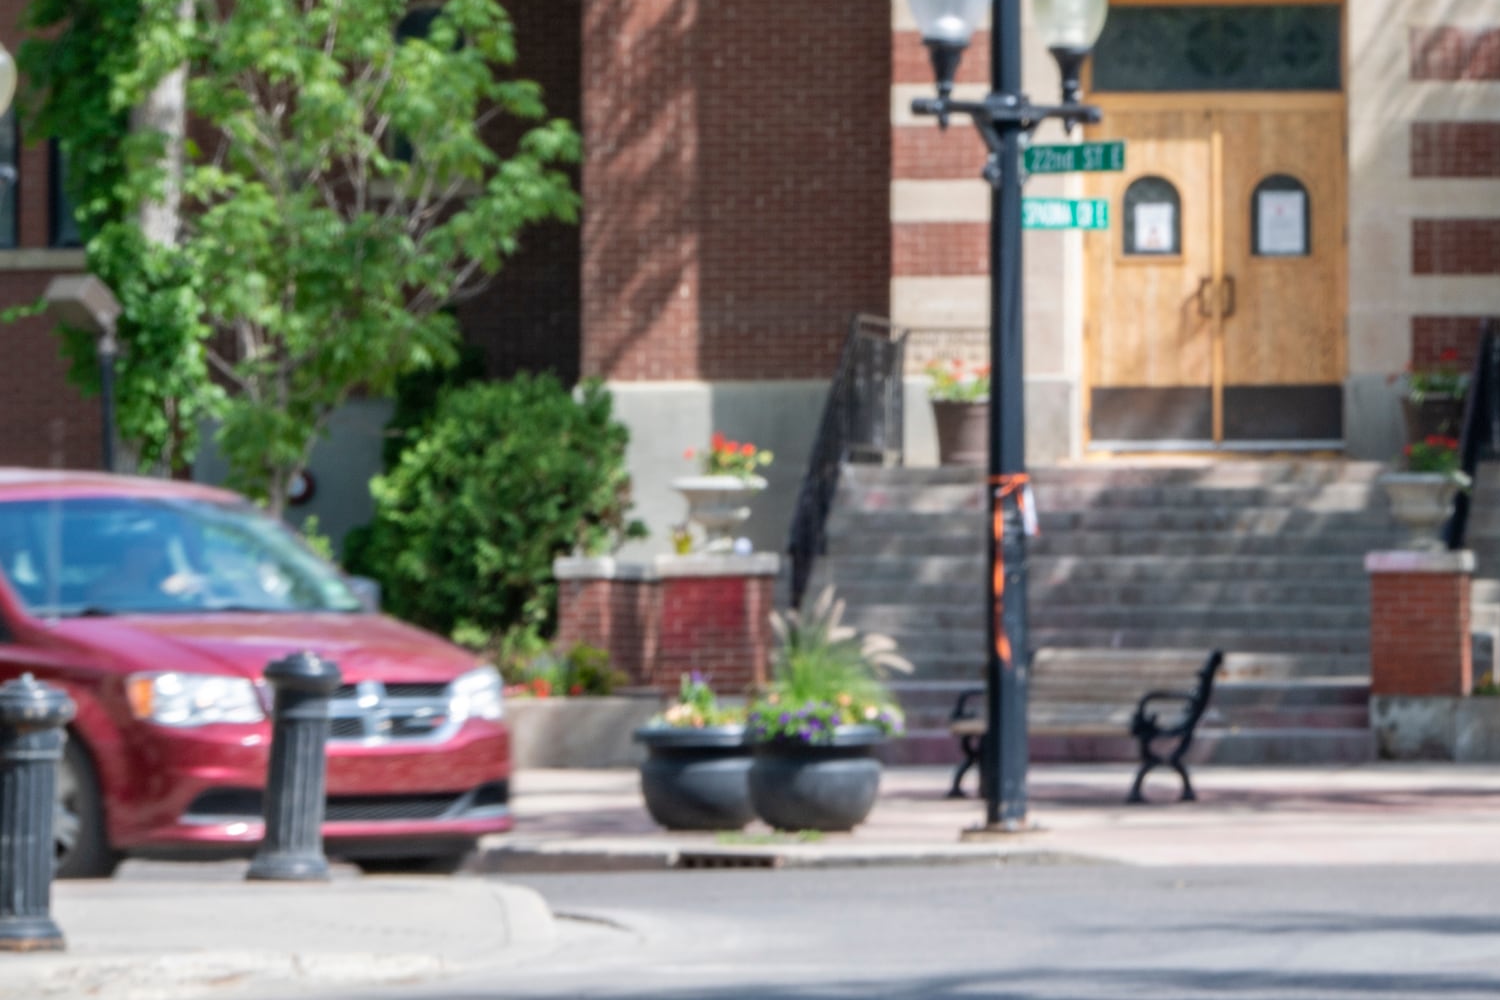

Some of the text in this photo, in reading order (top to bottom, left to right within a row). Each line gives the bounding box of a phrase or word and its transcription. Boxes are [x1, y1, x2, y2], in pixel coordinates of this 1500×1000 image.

[1031, 144, 1122, 172] 22nd ST E
